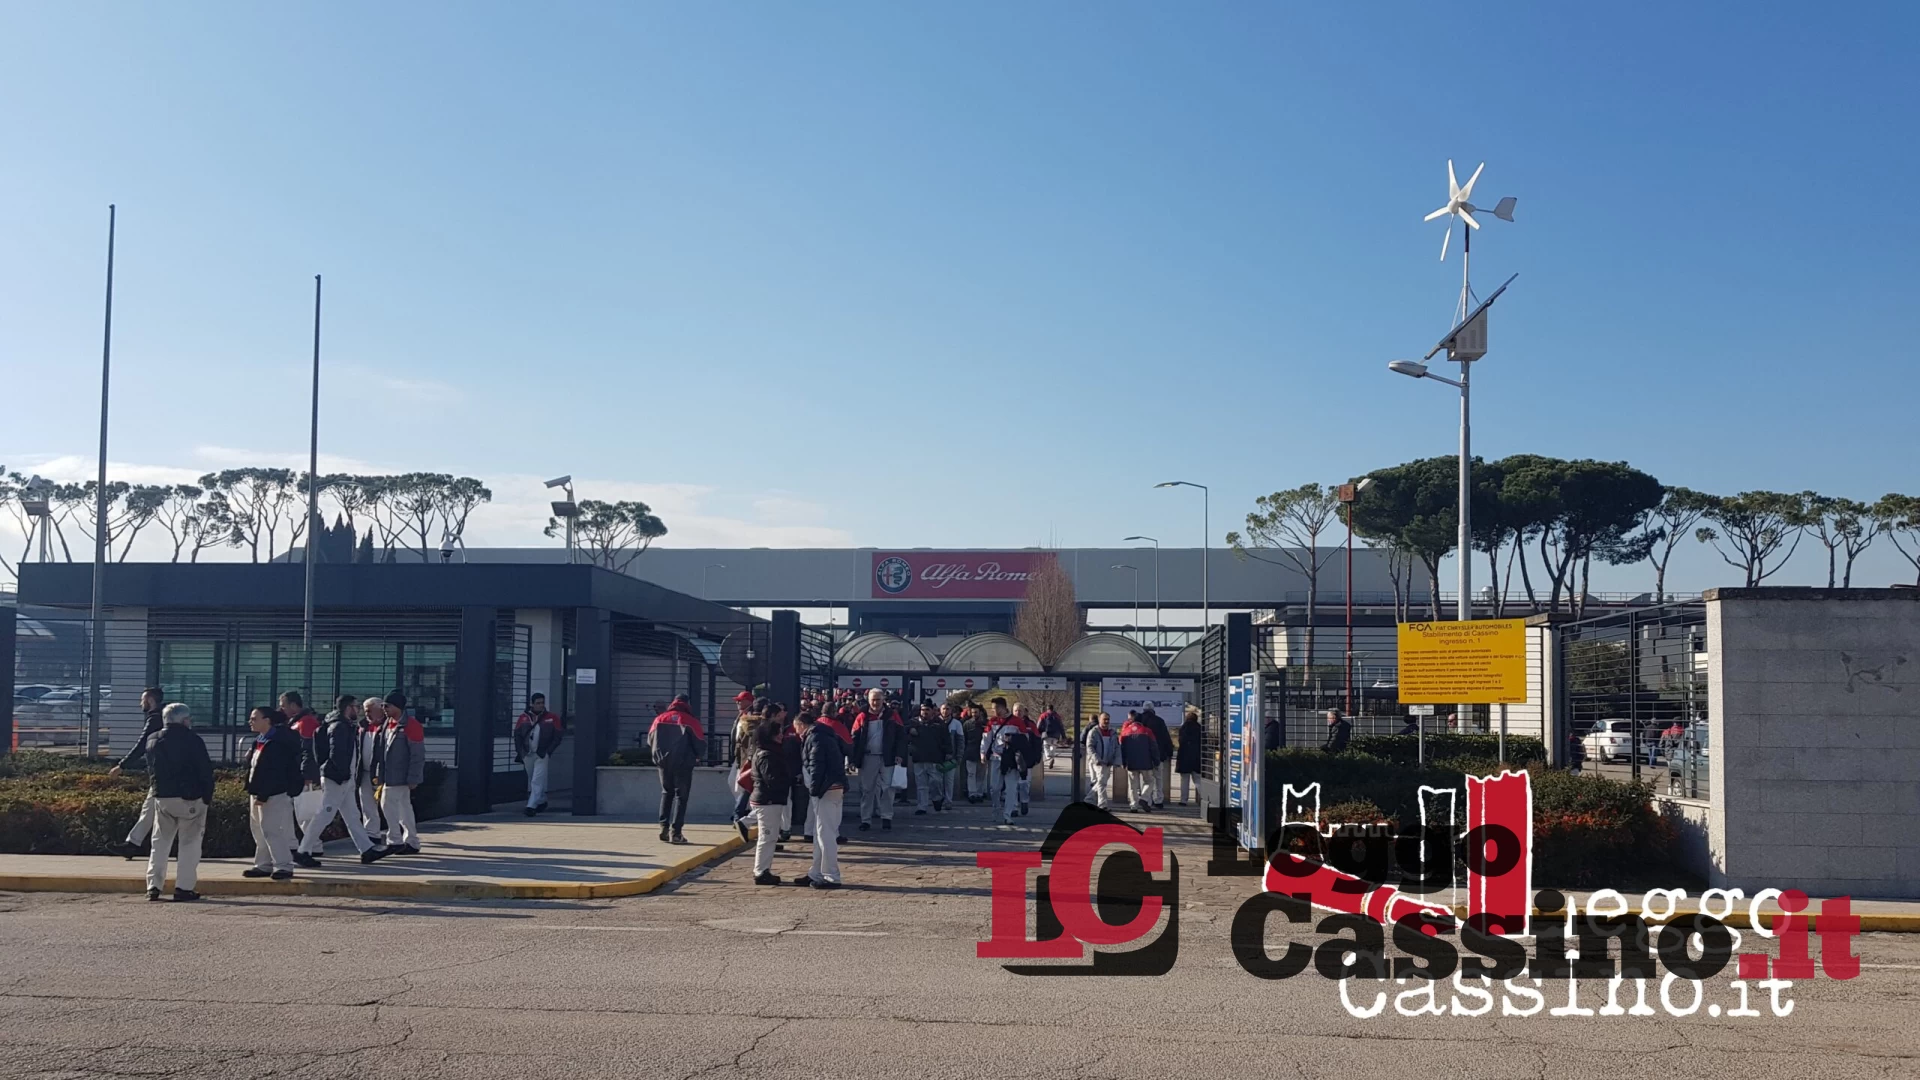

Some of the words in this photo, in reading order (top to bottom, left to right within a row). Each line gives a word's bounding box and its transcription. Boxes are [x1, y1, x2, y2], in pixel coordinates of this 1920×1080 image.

[920, 562, 973, 589] Alfa
[972, 561, 1044, 581] Rome
[1409, 623, 1432, 632] FCA
